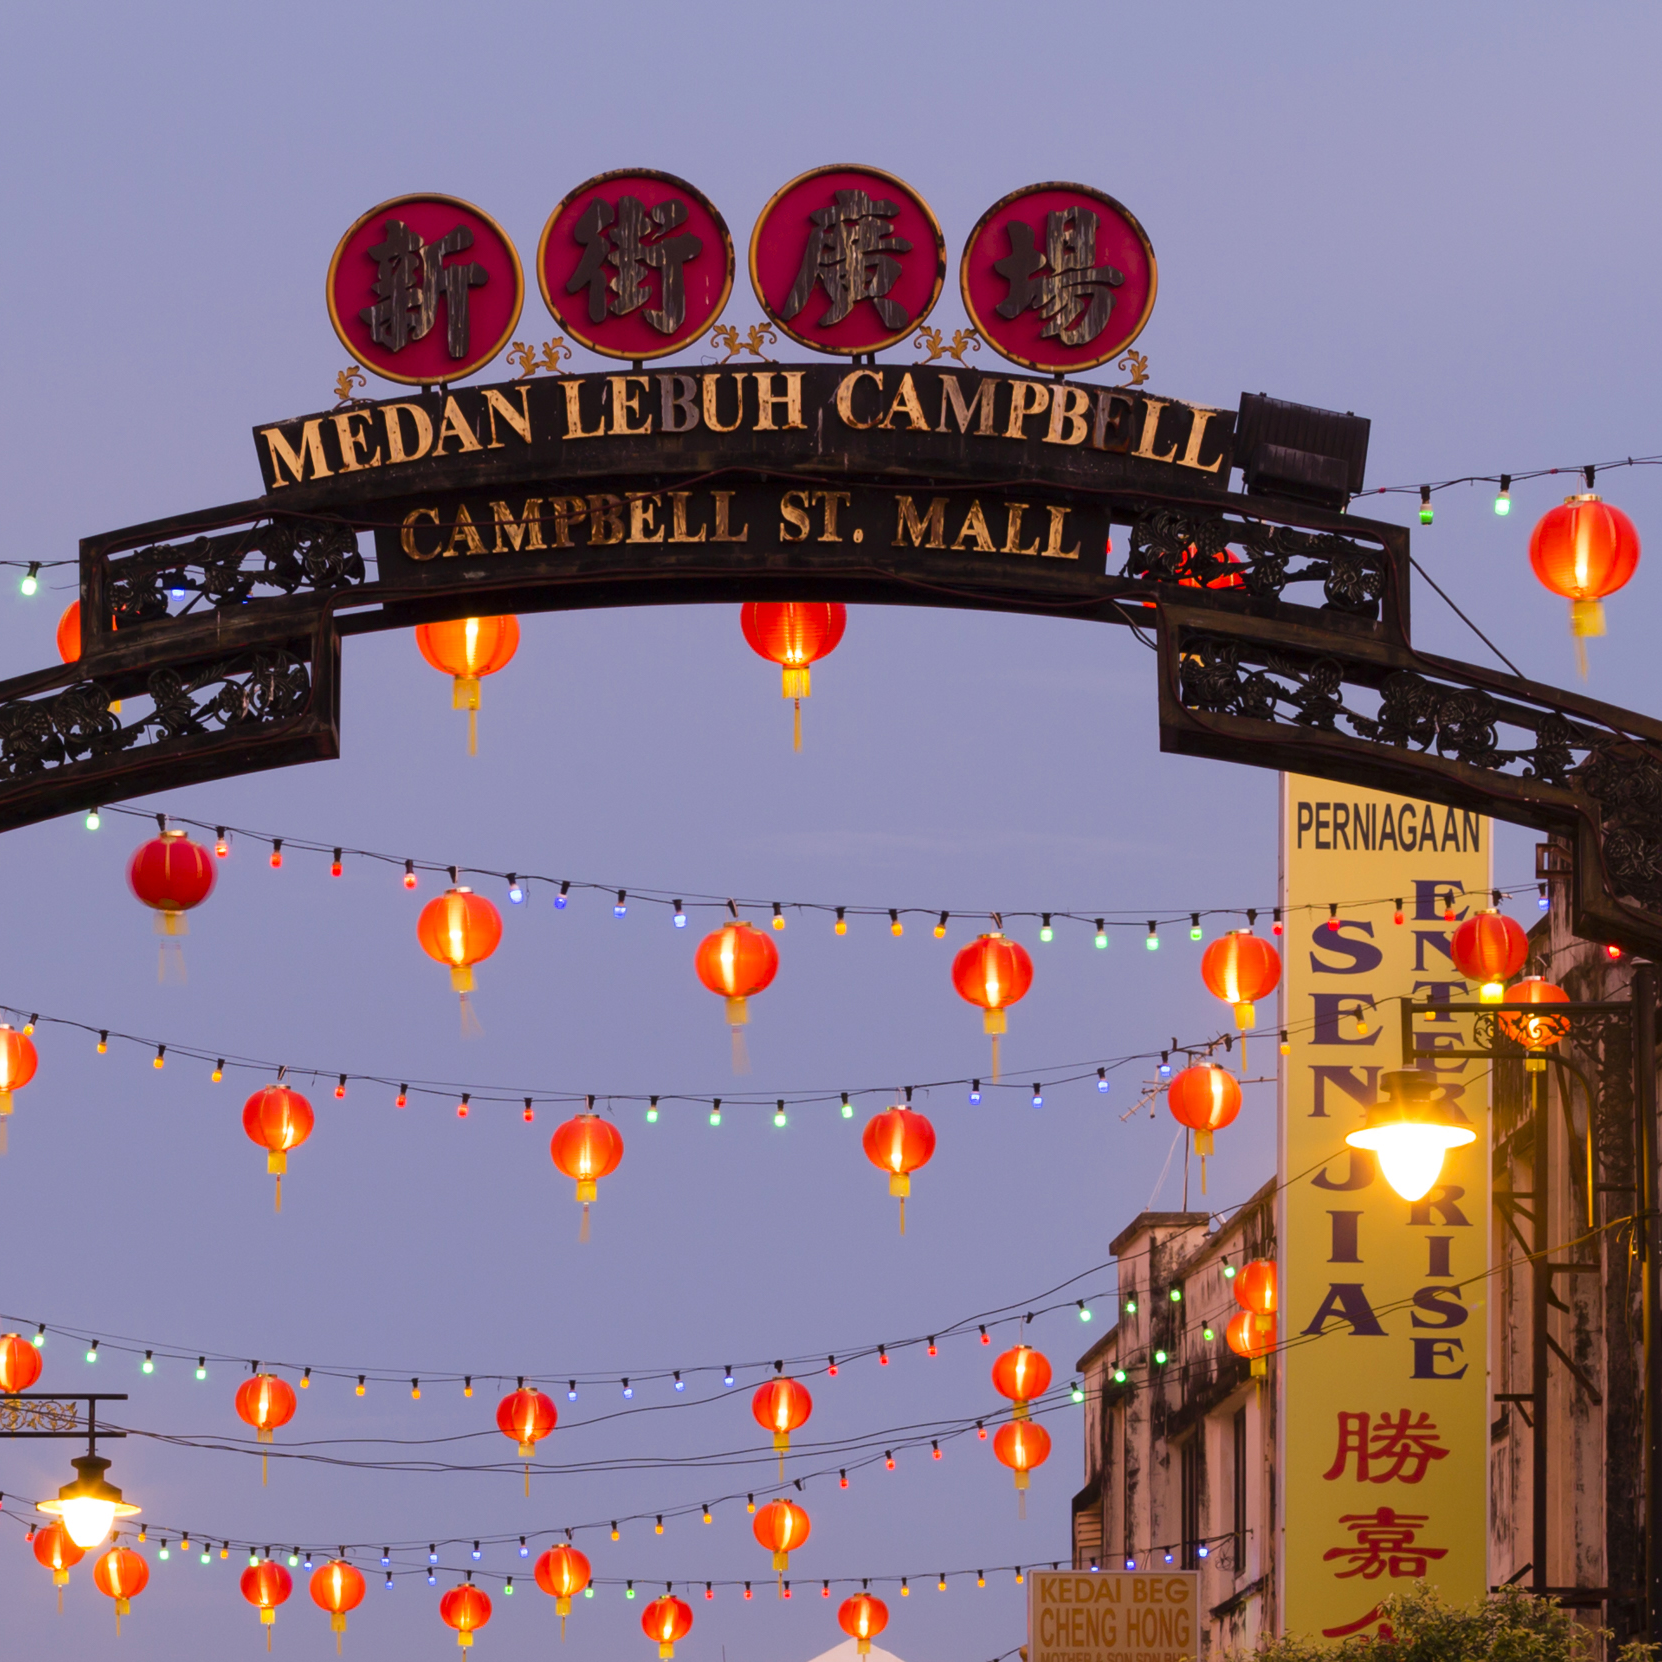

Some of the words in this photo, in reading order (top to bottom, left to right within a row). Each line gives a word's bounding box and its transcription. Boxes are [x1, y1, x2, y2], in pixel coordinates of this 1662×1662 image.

[259, 384, 535, 489] MEDAN
[560, 370, 807, 441] LEBUH
[836, 368, 1228, 476] CAMPBELL
[399, 490, 749, 565] CAMPBELL
[778, 489, 864, 543] ST.
[893, 494, 1083, 563] MALL
[1296, 800, 1482, 853] PERNIAGAAN
[1040, 1577, 1122, 1604] KEDAI
[1132, 1577, 1190, 1604] BEG
[1039, 1606, 1117, 1649] CHENG
[1126, 1606, 1190, 1649] HONG
